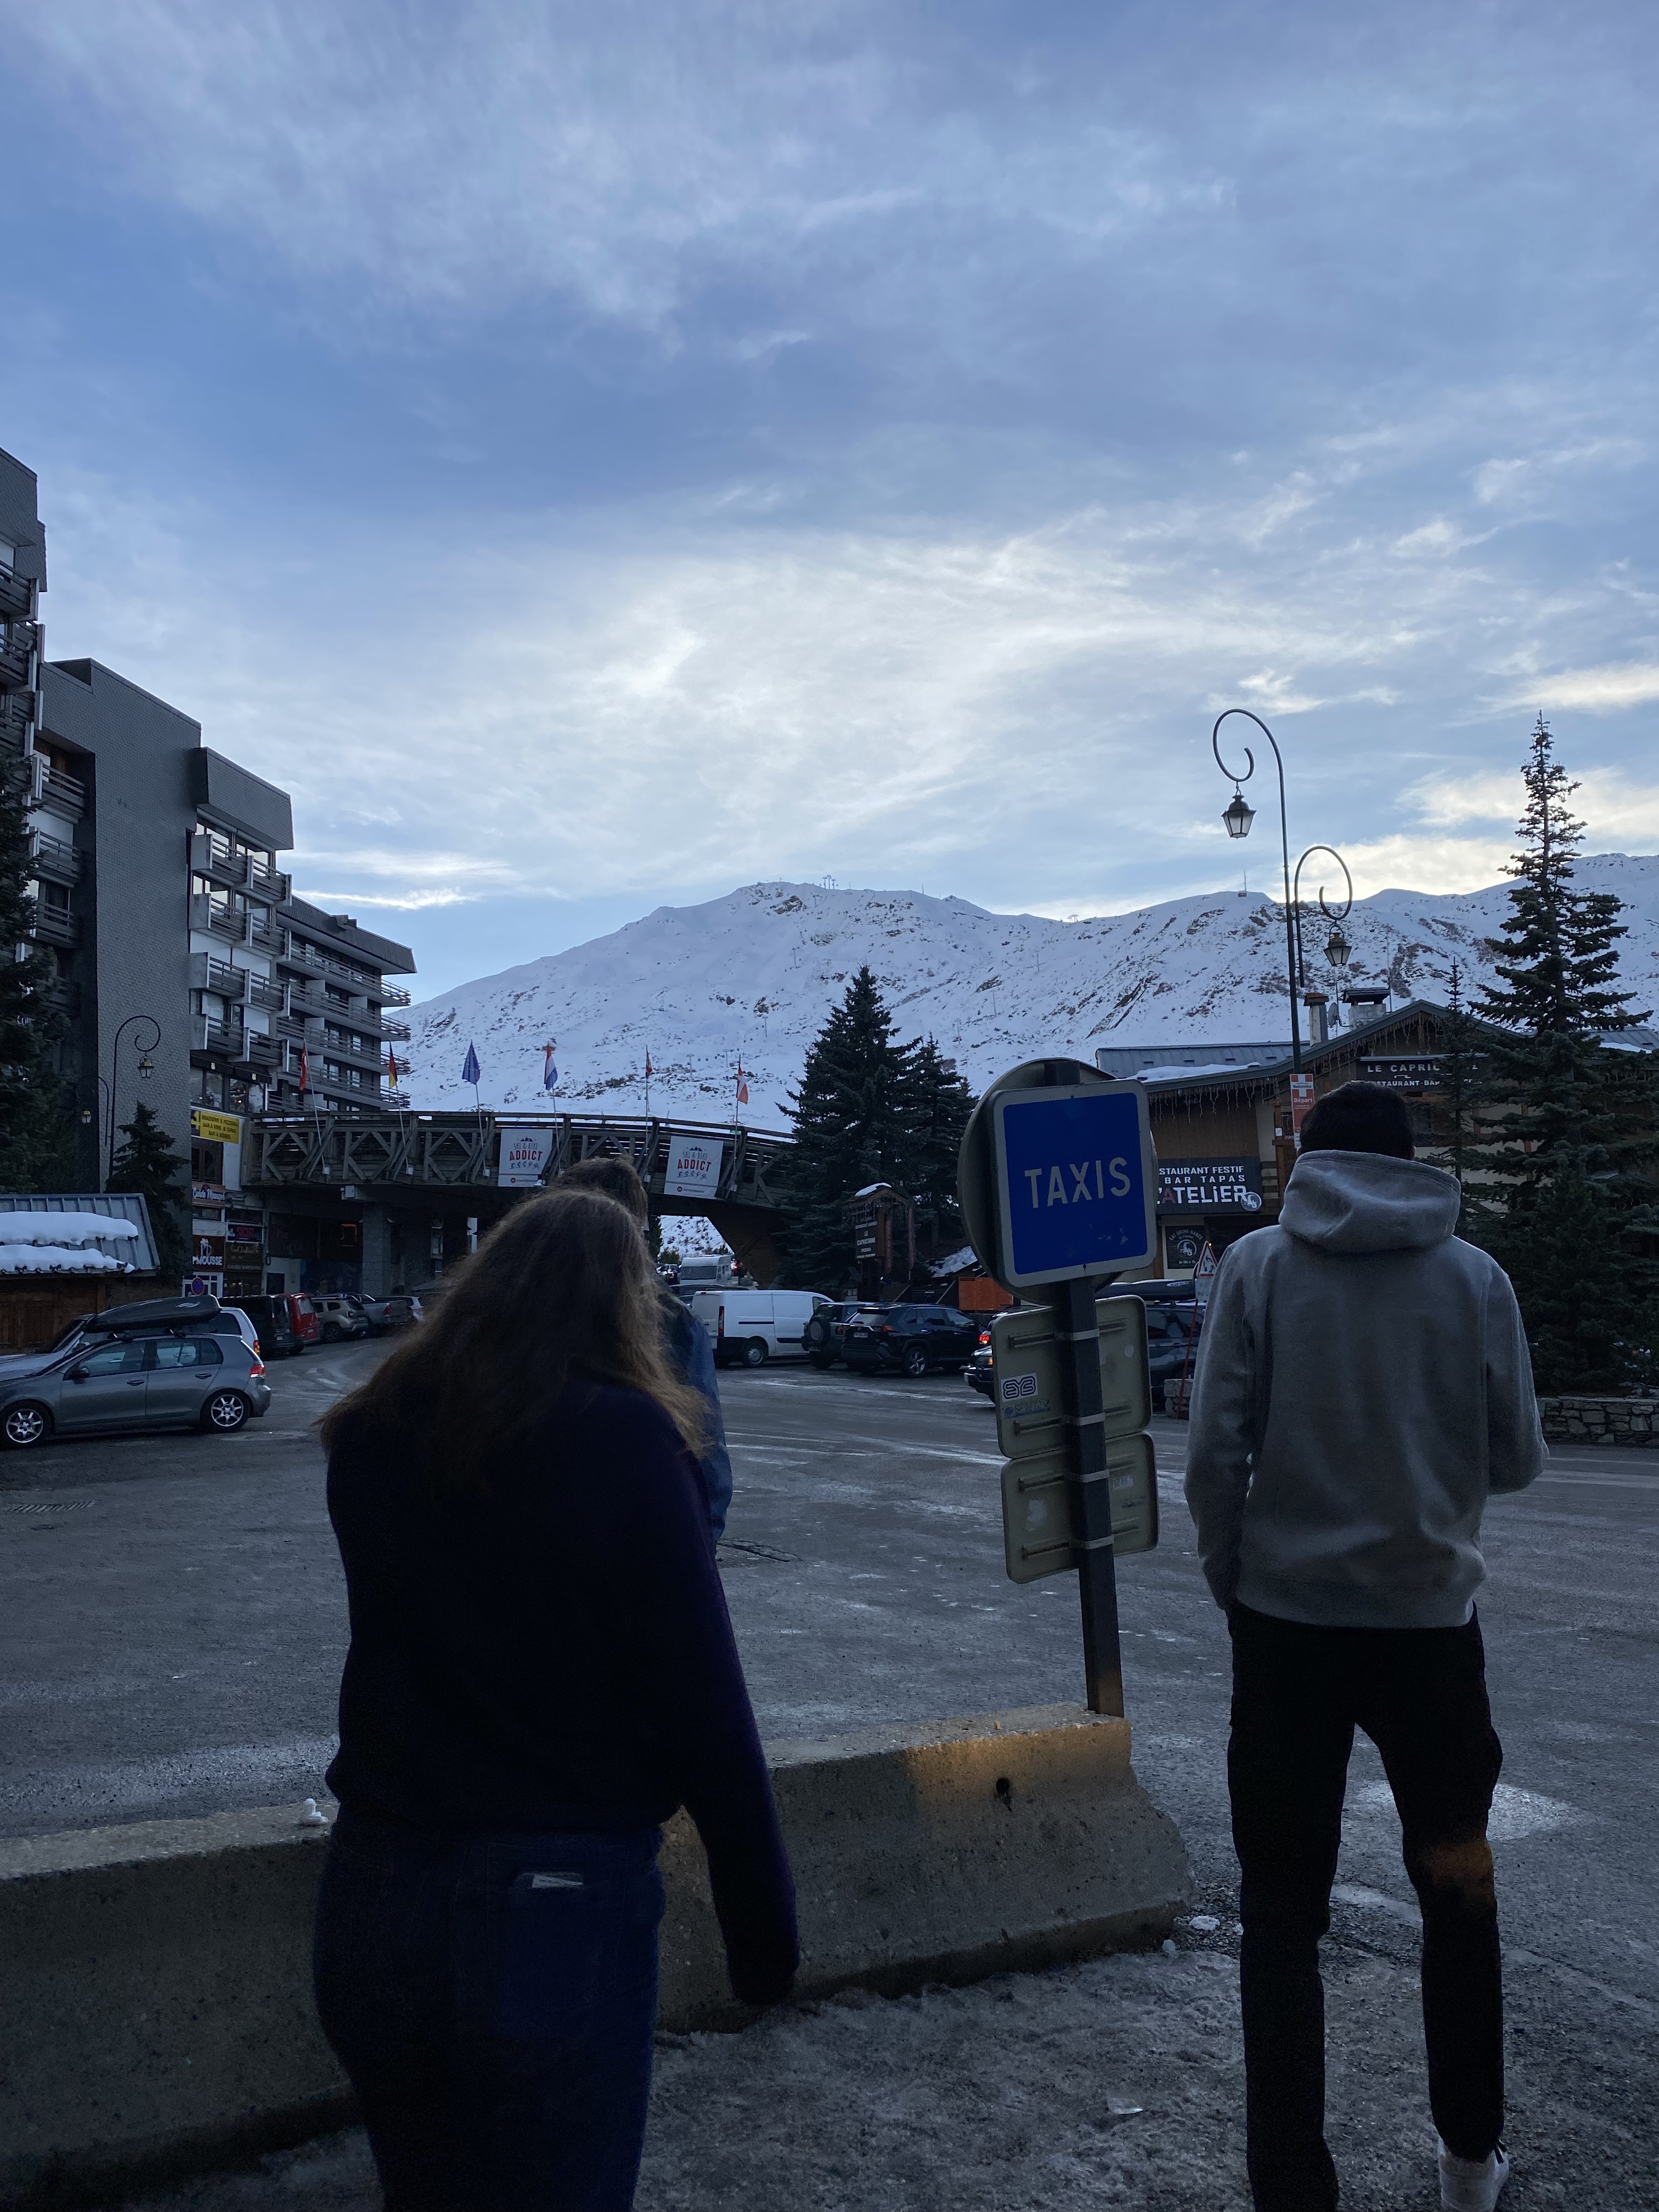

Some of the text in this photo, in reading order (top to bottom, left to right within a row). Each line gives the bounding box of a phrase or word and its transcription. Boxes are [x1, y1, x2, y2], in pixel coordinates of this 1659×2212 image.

[1368, 1065, 1382, 1073] LE
[510, 1150, 543, 1161] ADDICT
[677, 1159, 712, 1172] ADDICT
[1159, 1165, 1244, 1175] STAURANT FESTIF
[1025, 1157, 1131, 1209] TAXIS
[1165, 1175, 1245, 1184] BAR TAPAS
